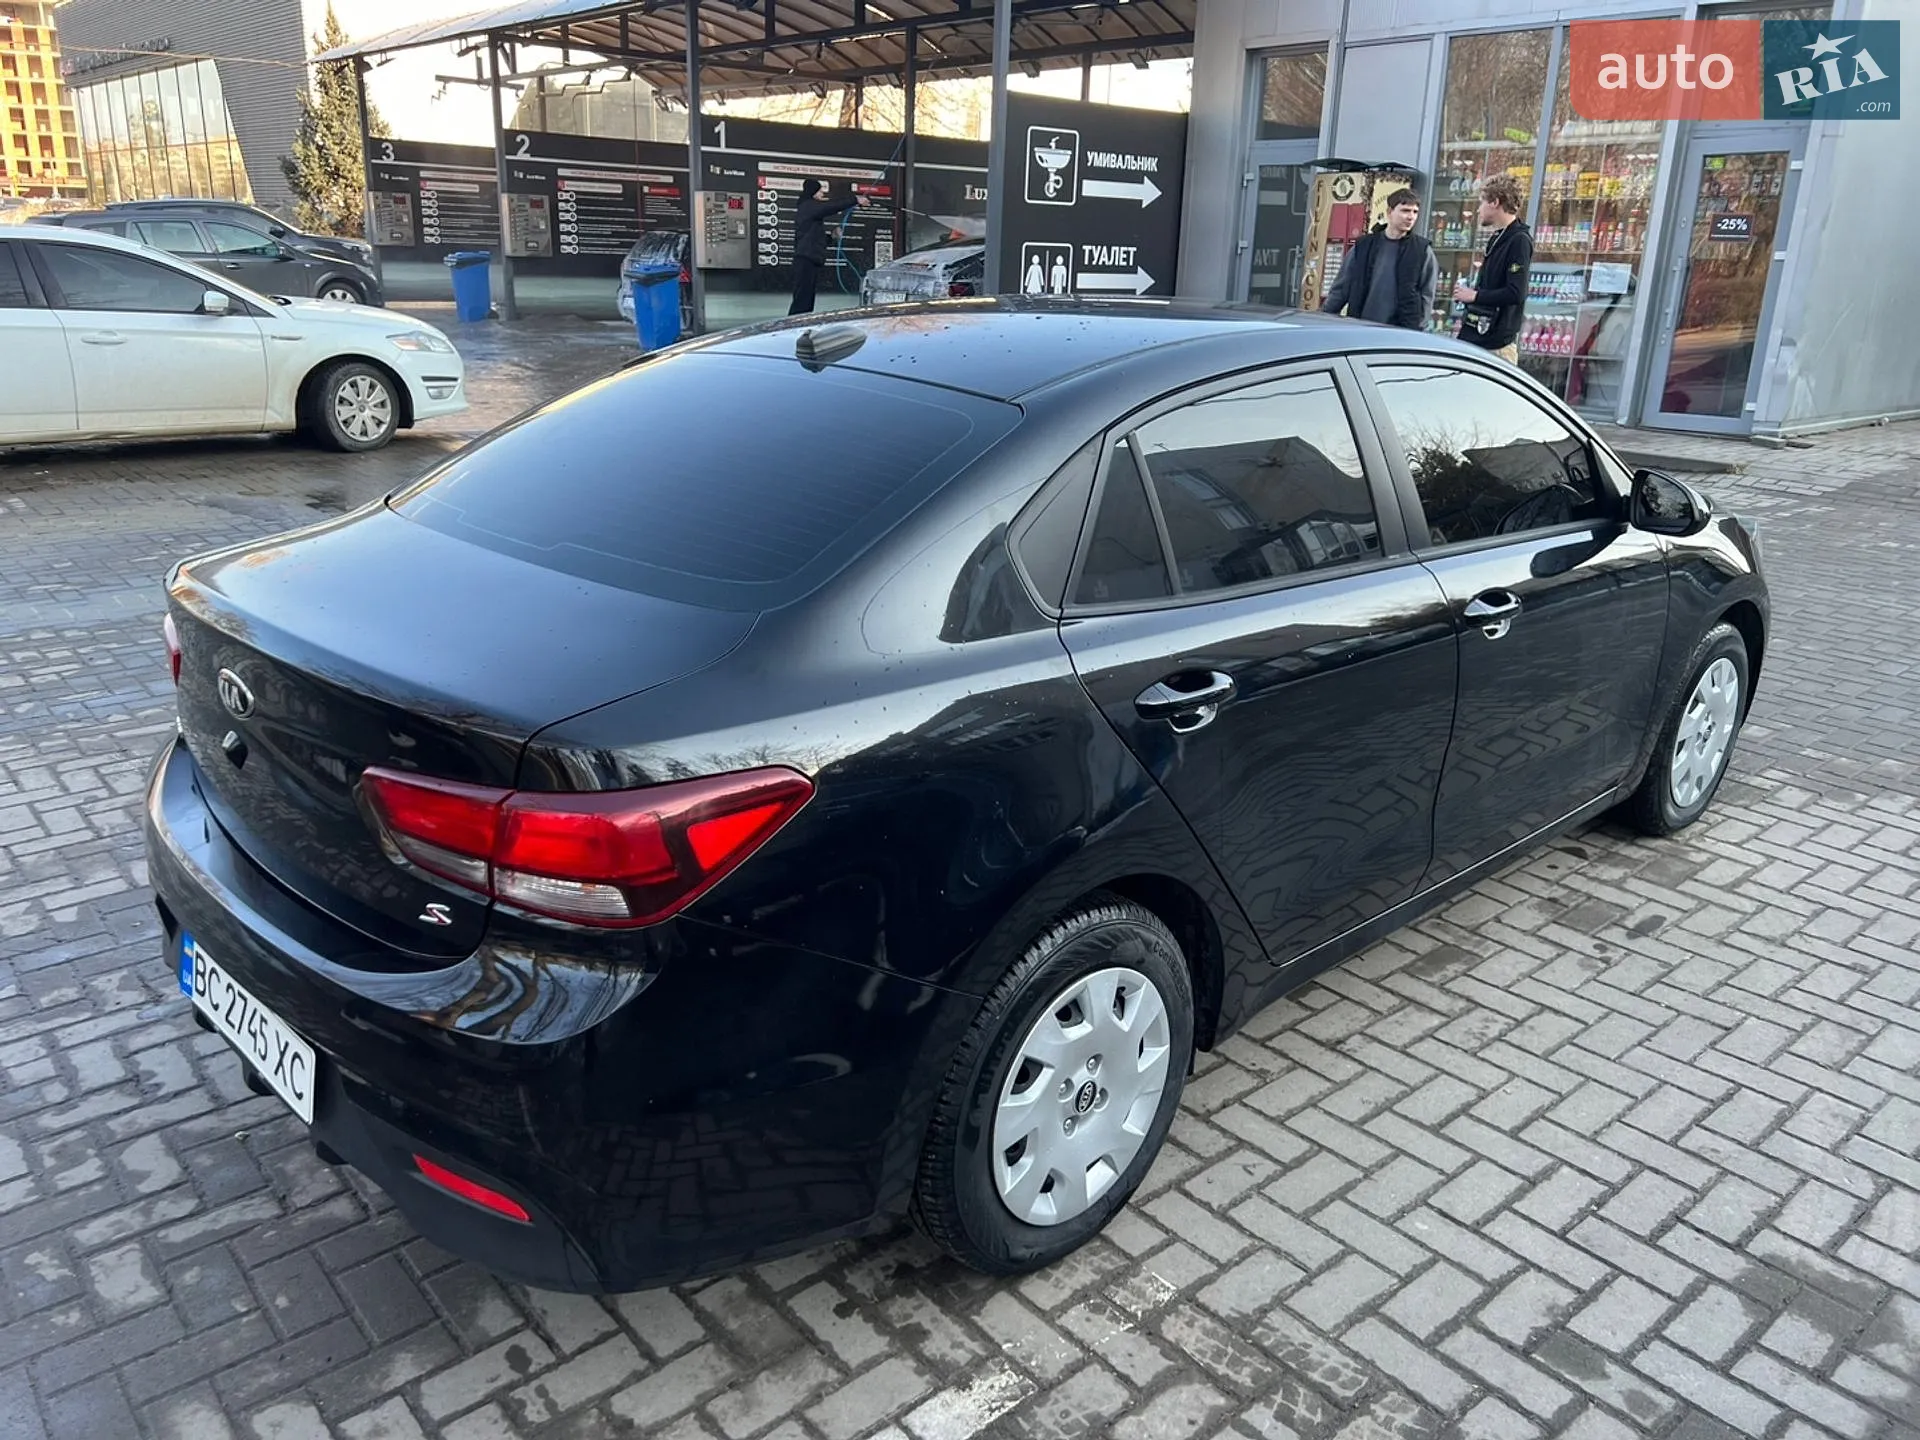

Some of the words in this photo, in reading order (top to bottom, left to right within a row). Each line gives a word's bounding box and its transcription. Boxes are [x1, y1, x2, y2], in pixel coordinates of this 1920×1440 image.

[714, 121, 726, 148] 1
[379, 142, 395, 161] 3
[515, 134, 531, 158] 2
[1087, 151, 1158, 172] УМИВАЛЬНИК
[1717, 218, 1748, 231] -25%
[1082, 246, 1137, 267] ТУАЛЕТ
[418, 902, 452, 926] S
[195, 950, 221, 1012] BC
[225, 982, 268, 1062] 2745
[274, 1030, 305, 1101] XC
